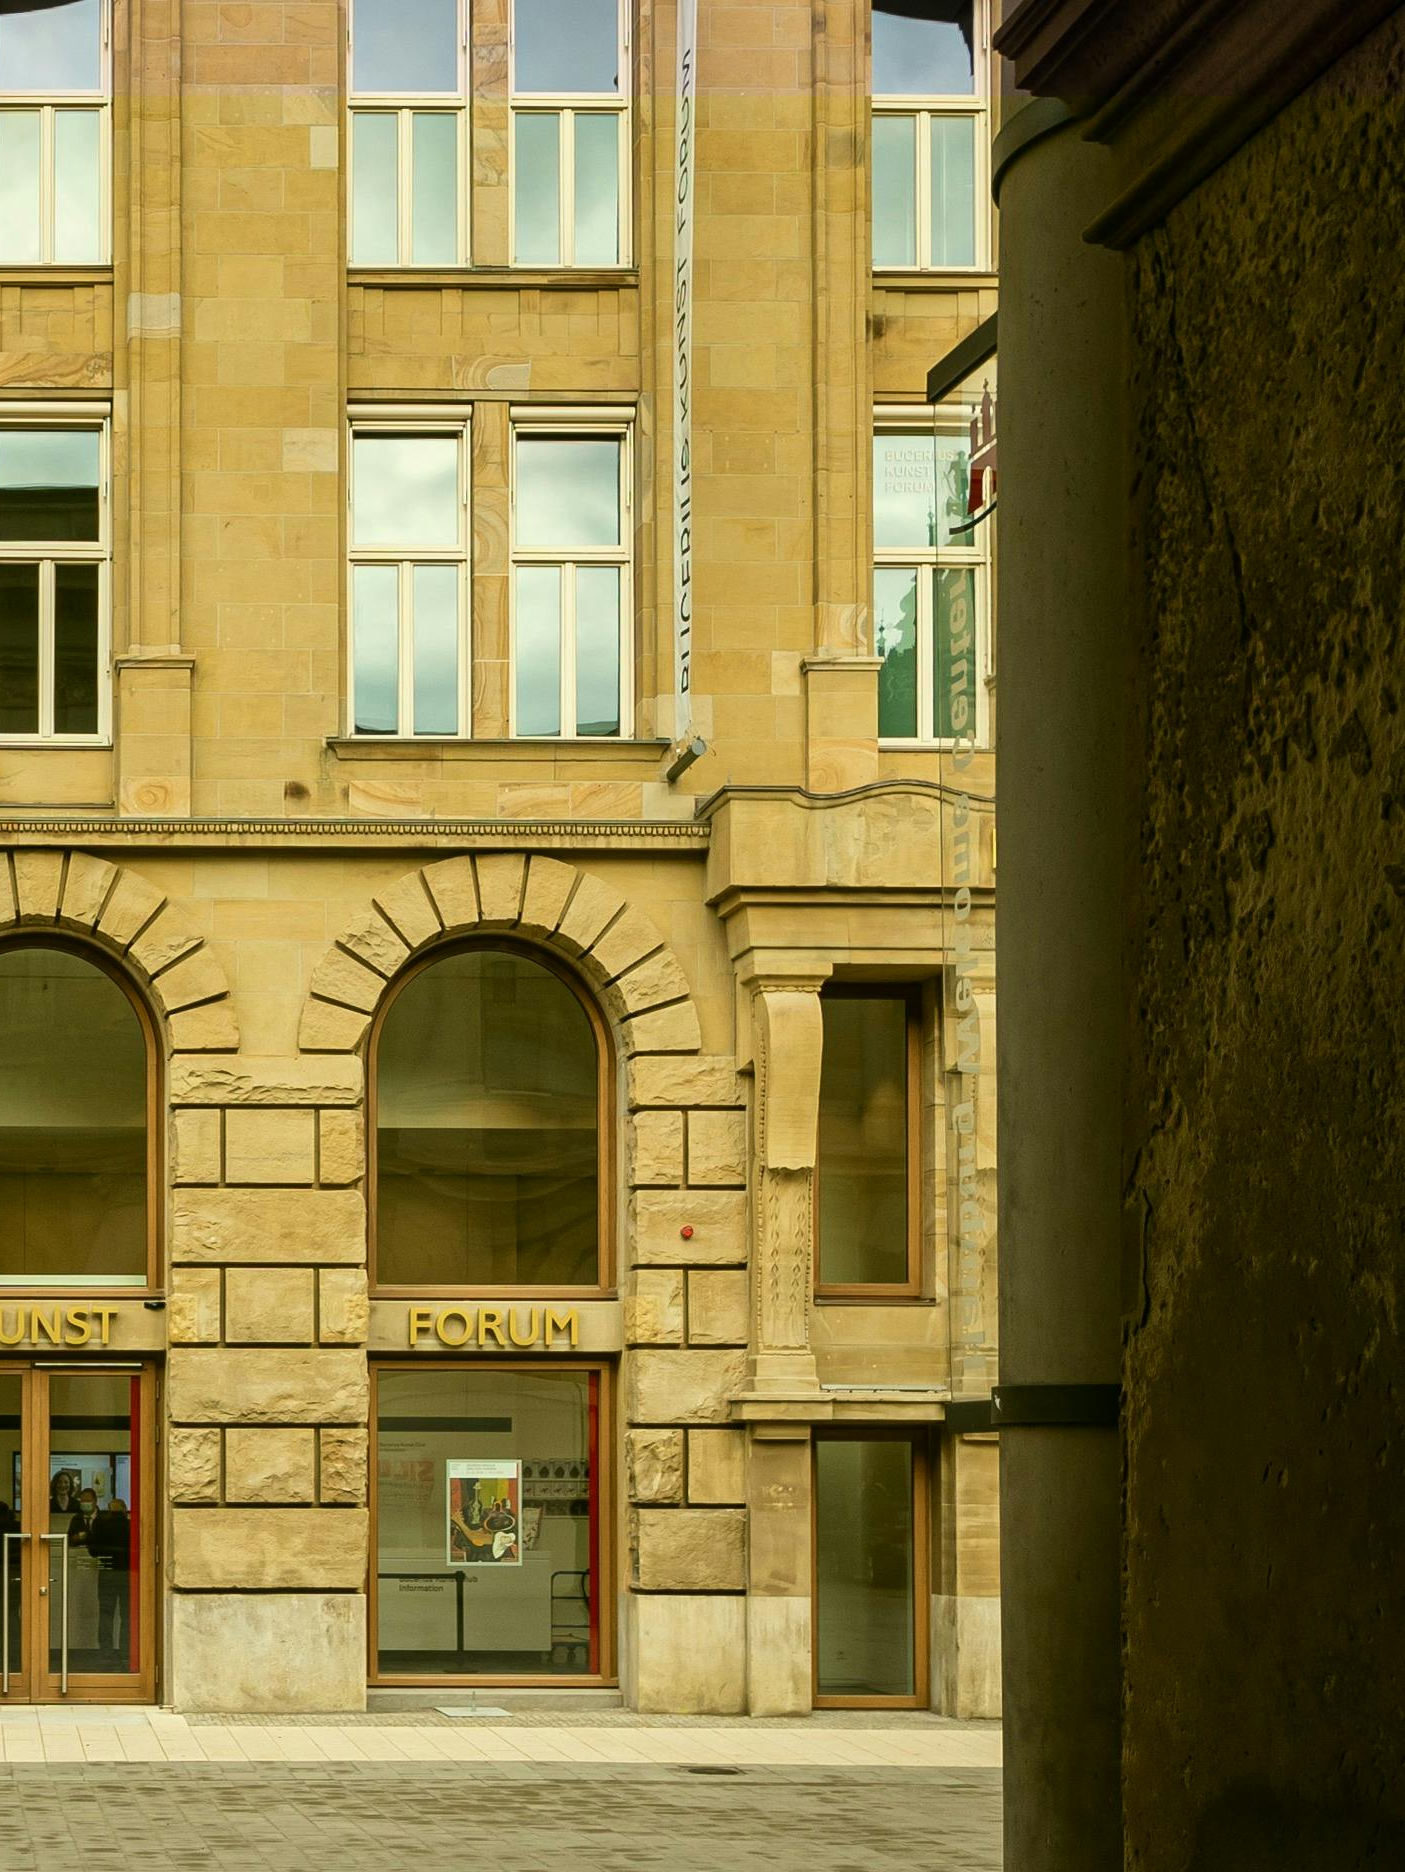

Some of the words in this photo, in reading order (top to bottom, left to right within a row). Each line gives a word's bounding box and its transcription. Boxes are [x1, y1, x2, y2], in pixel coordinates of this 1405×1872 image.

[676, 48, 691, 236] FORUM
[676, 257, 689, 423] KUNST
[884, 464, 932, 478] KUNST
[884, 481, 936, 494] FORUM
[408, 1306, 580, 1347] FORUM
[398, 1584, 444, 1593] Information
